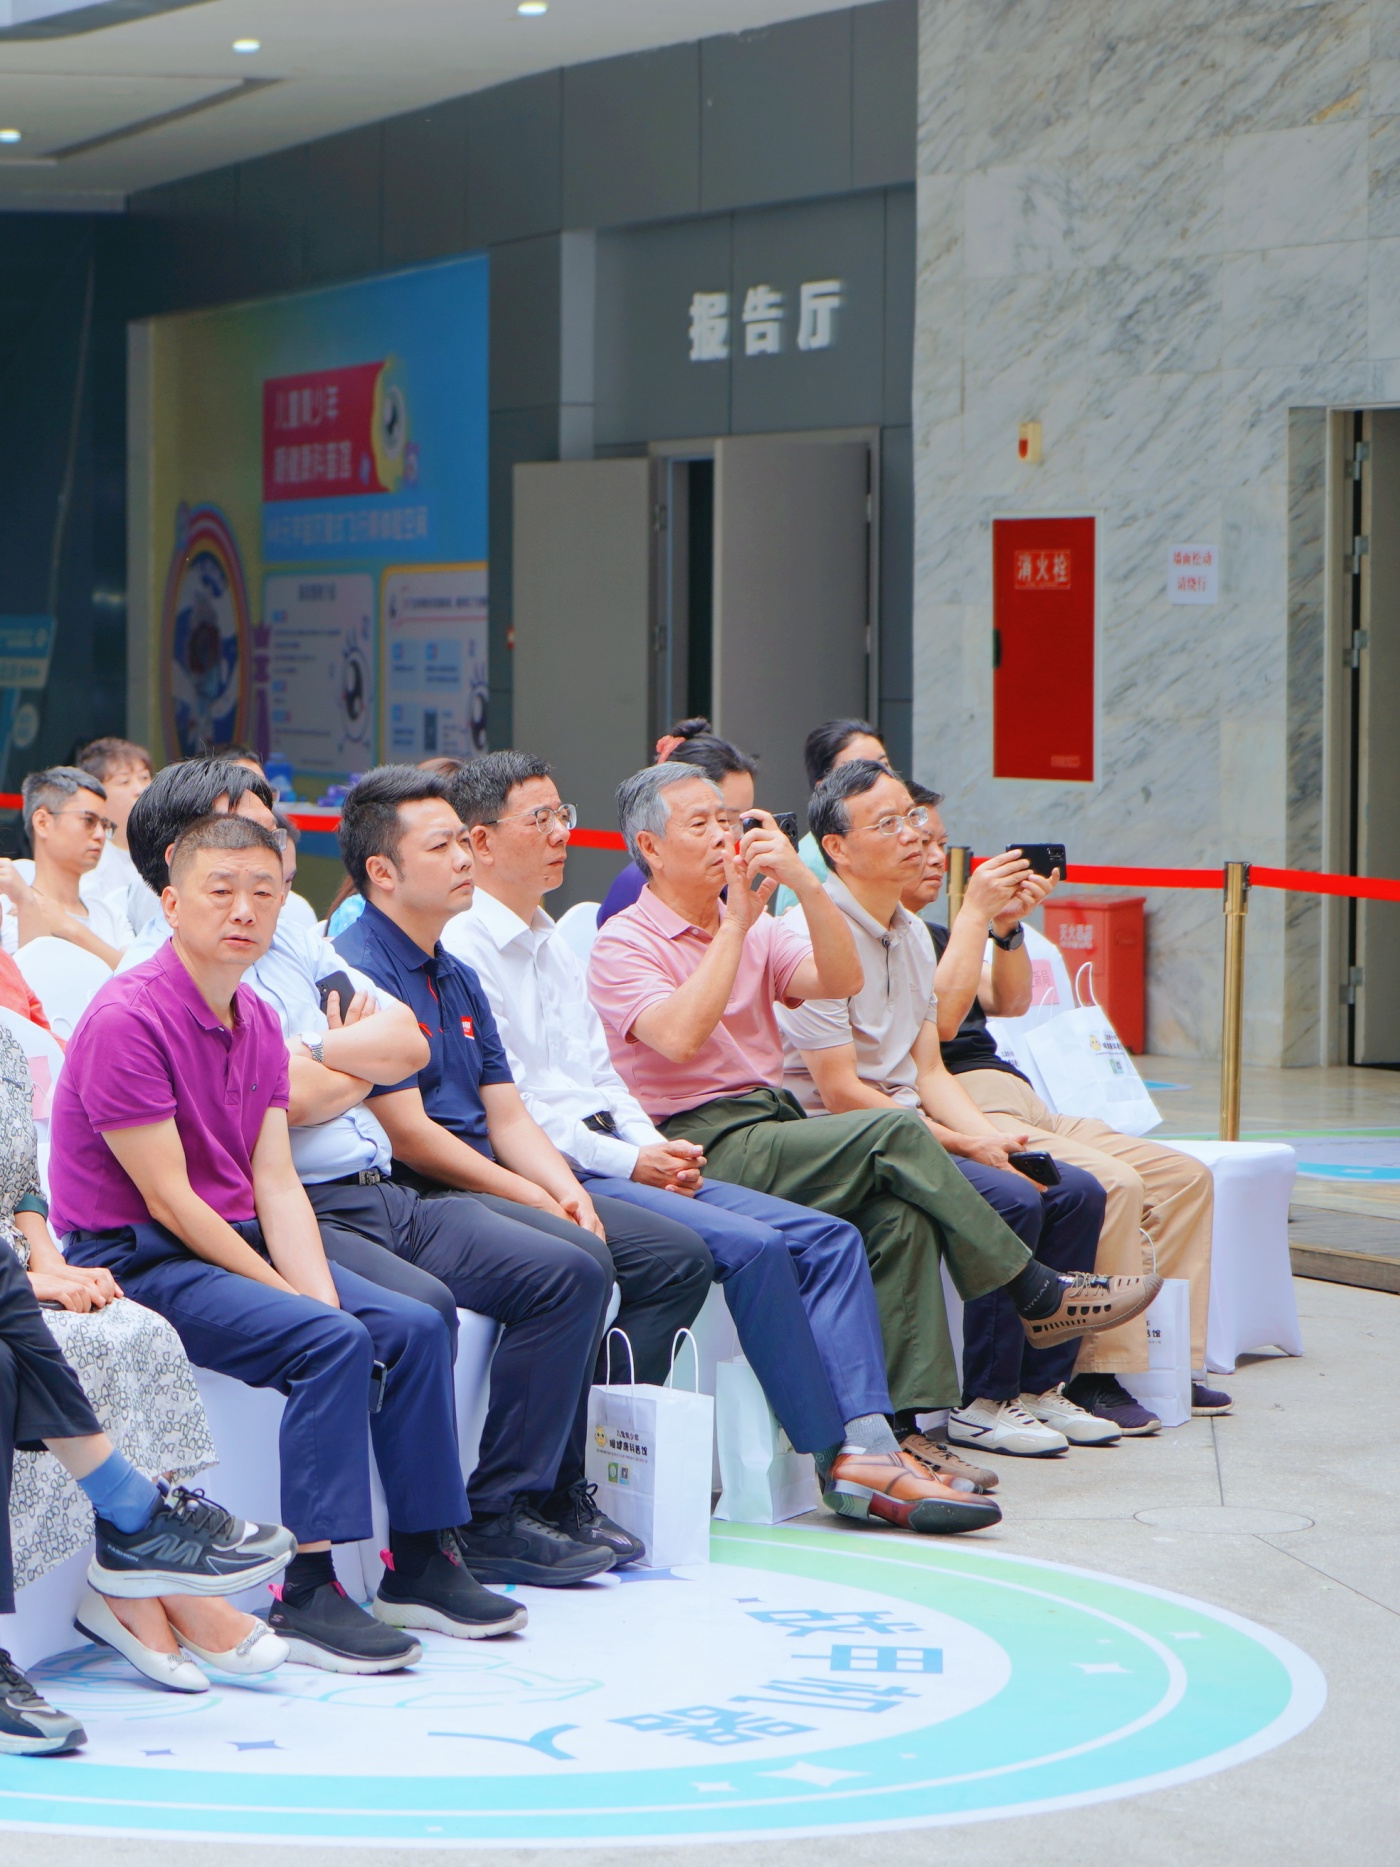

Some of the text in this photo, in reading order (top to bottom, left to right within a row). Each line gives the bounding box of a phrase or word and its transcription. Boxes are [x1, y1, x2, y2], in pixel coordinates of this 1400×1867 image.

[689, 279, 841, 362] 报告厅
[1017, 554, 1068, 583] 消火栓
[1173, 552, 1212, 567] 墙面松动
[1177, 576, 1207, 592] 请绕行
[107, 1543, 139, 1562] FASHION
[428, 1609, 943, 1760] 战甲机器人
